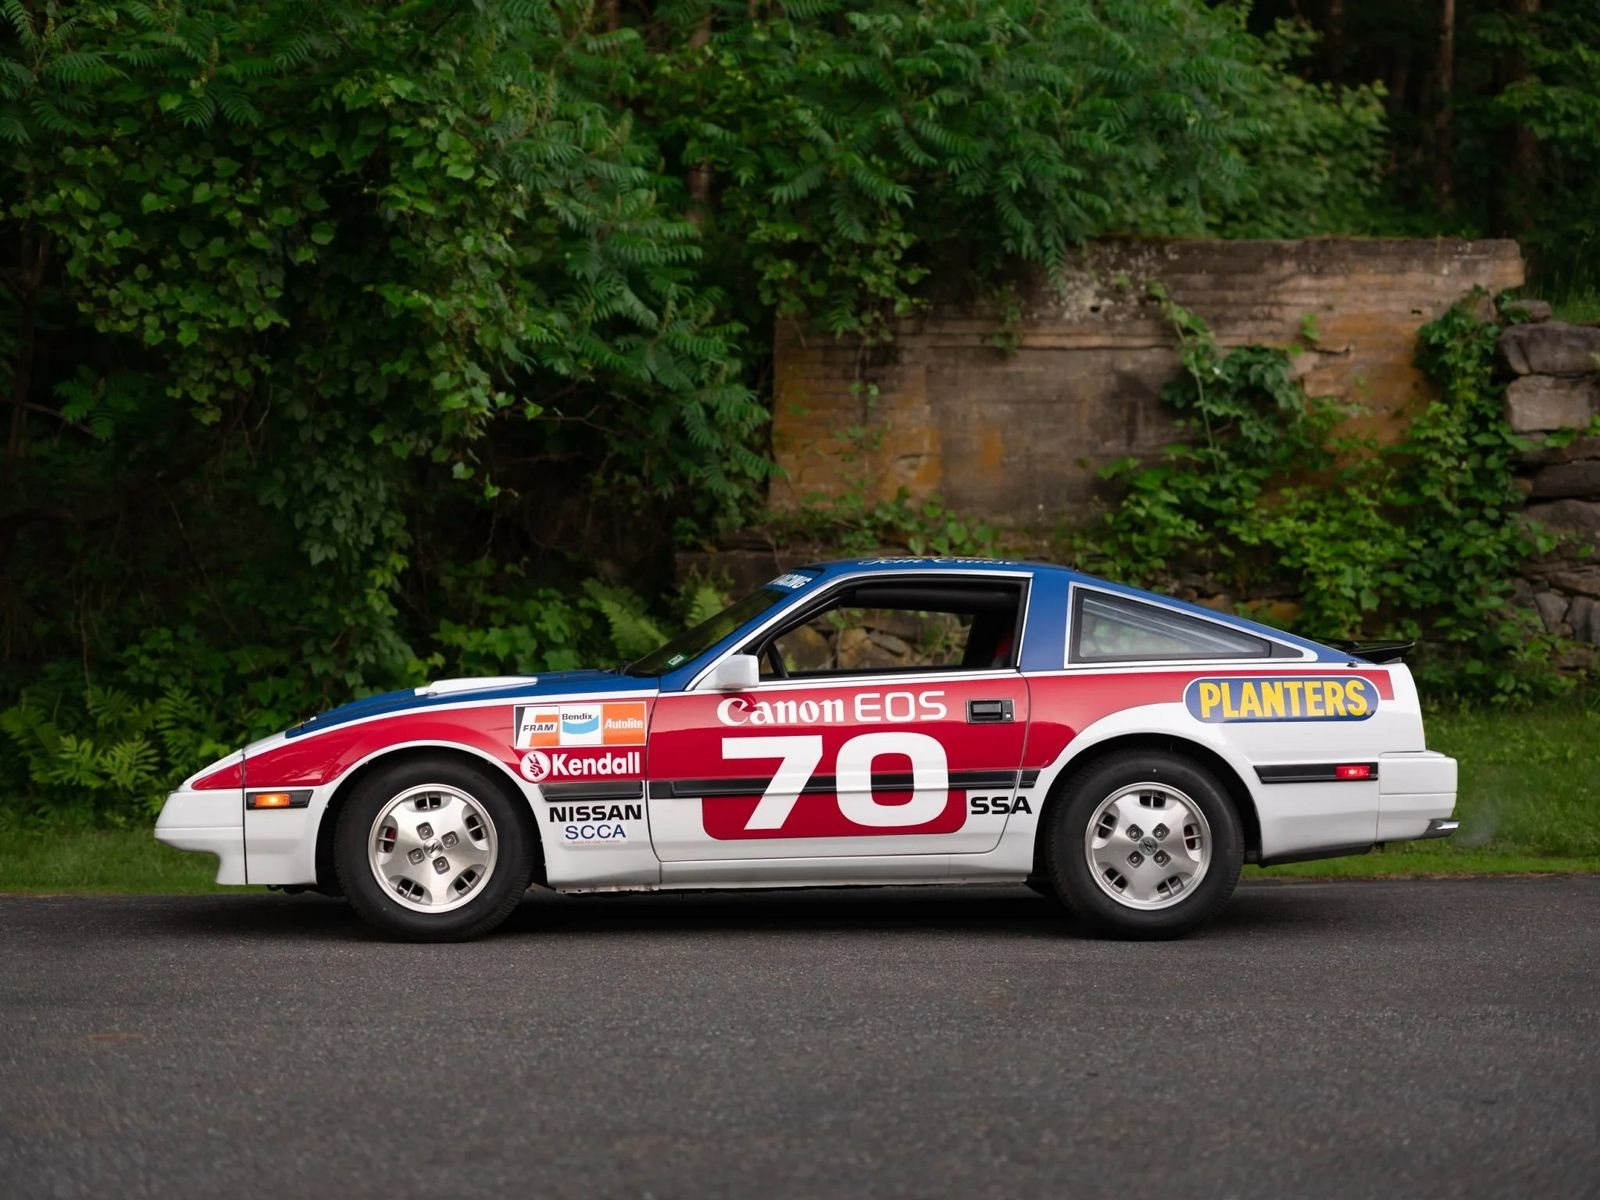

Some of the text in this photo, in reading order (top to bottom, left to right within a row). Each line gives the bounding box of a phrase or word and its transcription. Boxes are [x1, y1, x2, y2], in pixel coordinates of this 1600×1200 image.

[1199, 679, 1369, 718] PLANTERS
[561, 713, 593, 721] Bendix
[716, 690, 948, 726] Canon EOS
[523, 723, 554, 732] FRAM
[604, 718, 644, 730] Autolite
[551, 751, 641, 776] Kendall
[721, 731, 949, 831] 70
[549, 804, 642, 822] NISSAN
[970, 796, 1032, 815] SSA
[565, 824, 626, 840] SCCA
